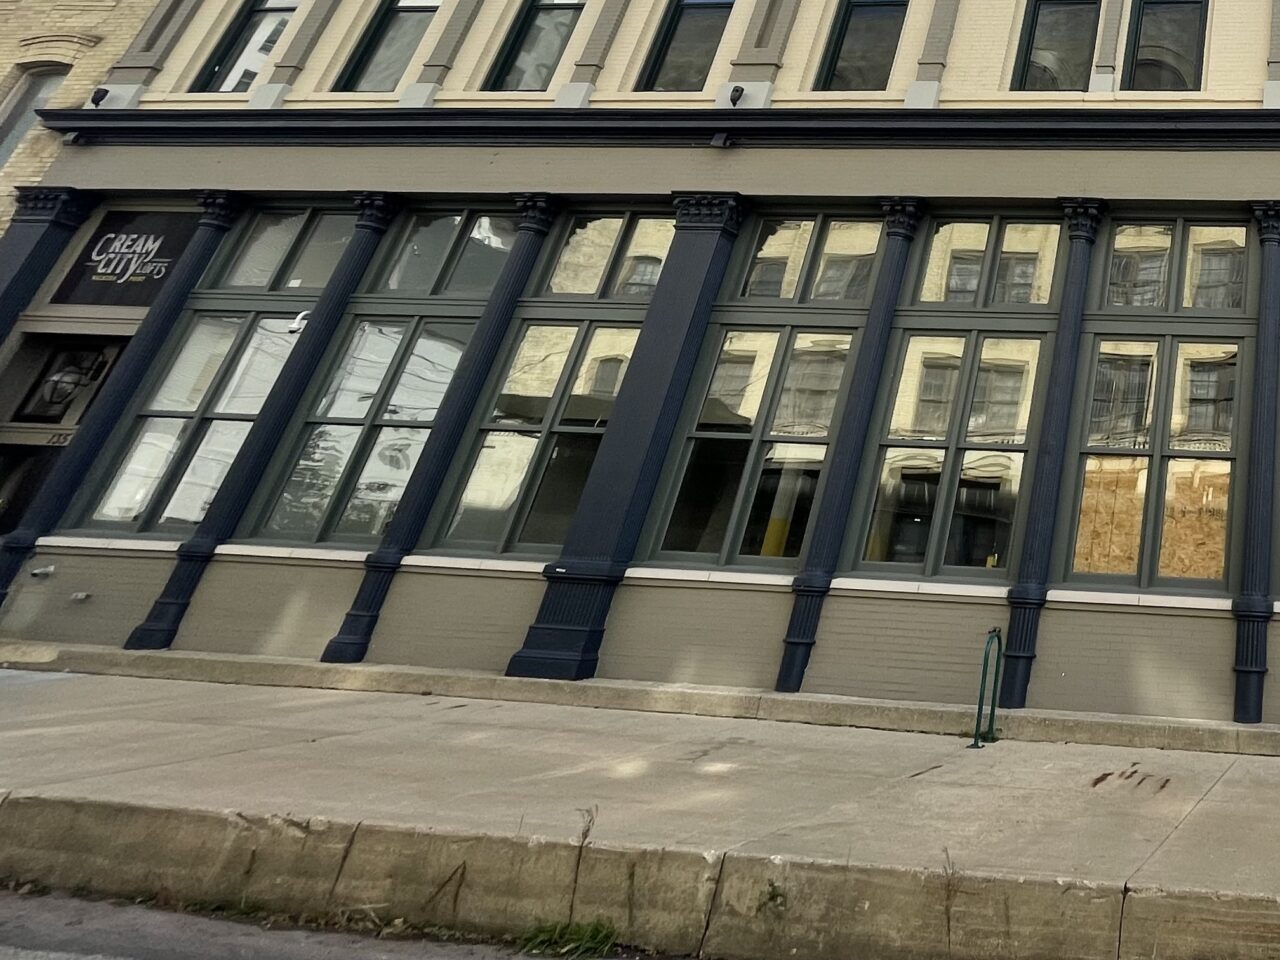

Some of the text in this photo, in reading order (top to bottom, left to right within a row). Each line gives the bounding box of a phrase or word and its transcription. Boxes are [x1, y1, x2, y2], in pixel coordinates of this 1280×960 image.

[91, 233, 165, 262] CREAM
[97, 253, 168, 284] CITY LOFTS
